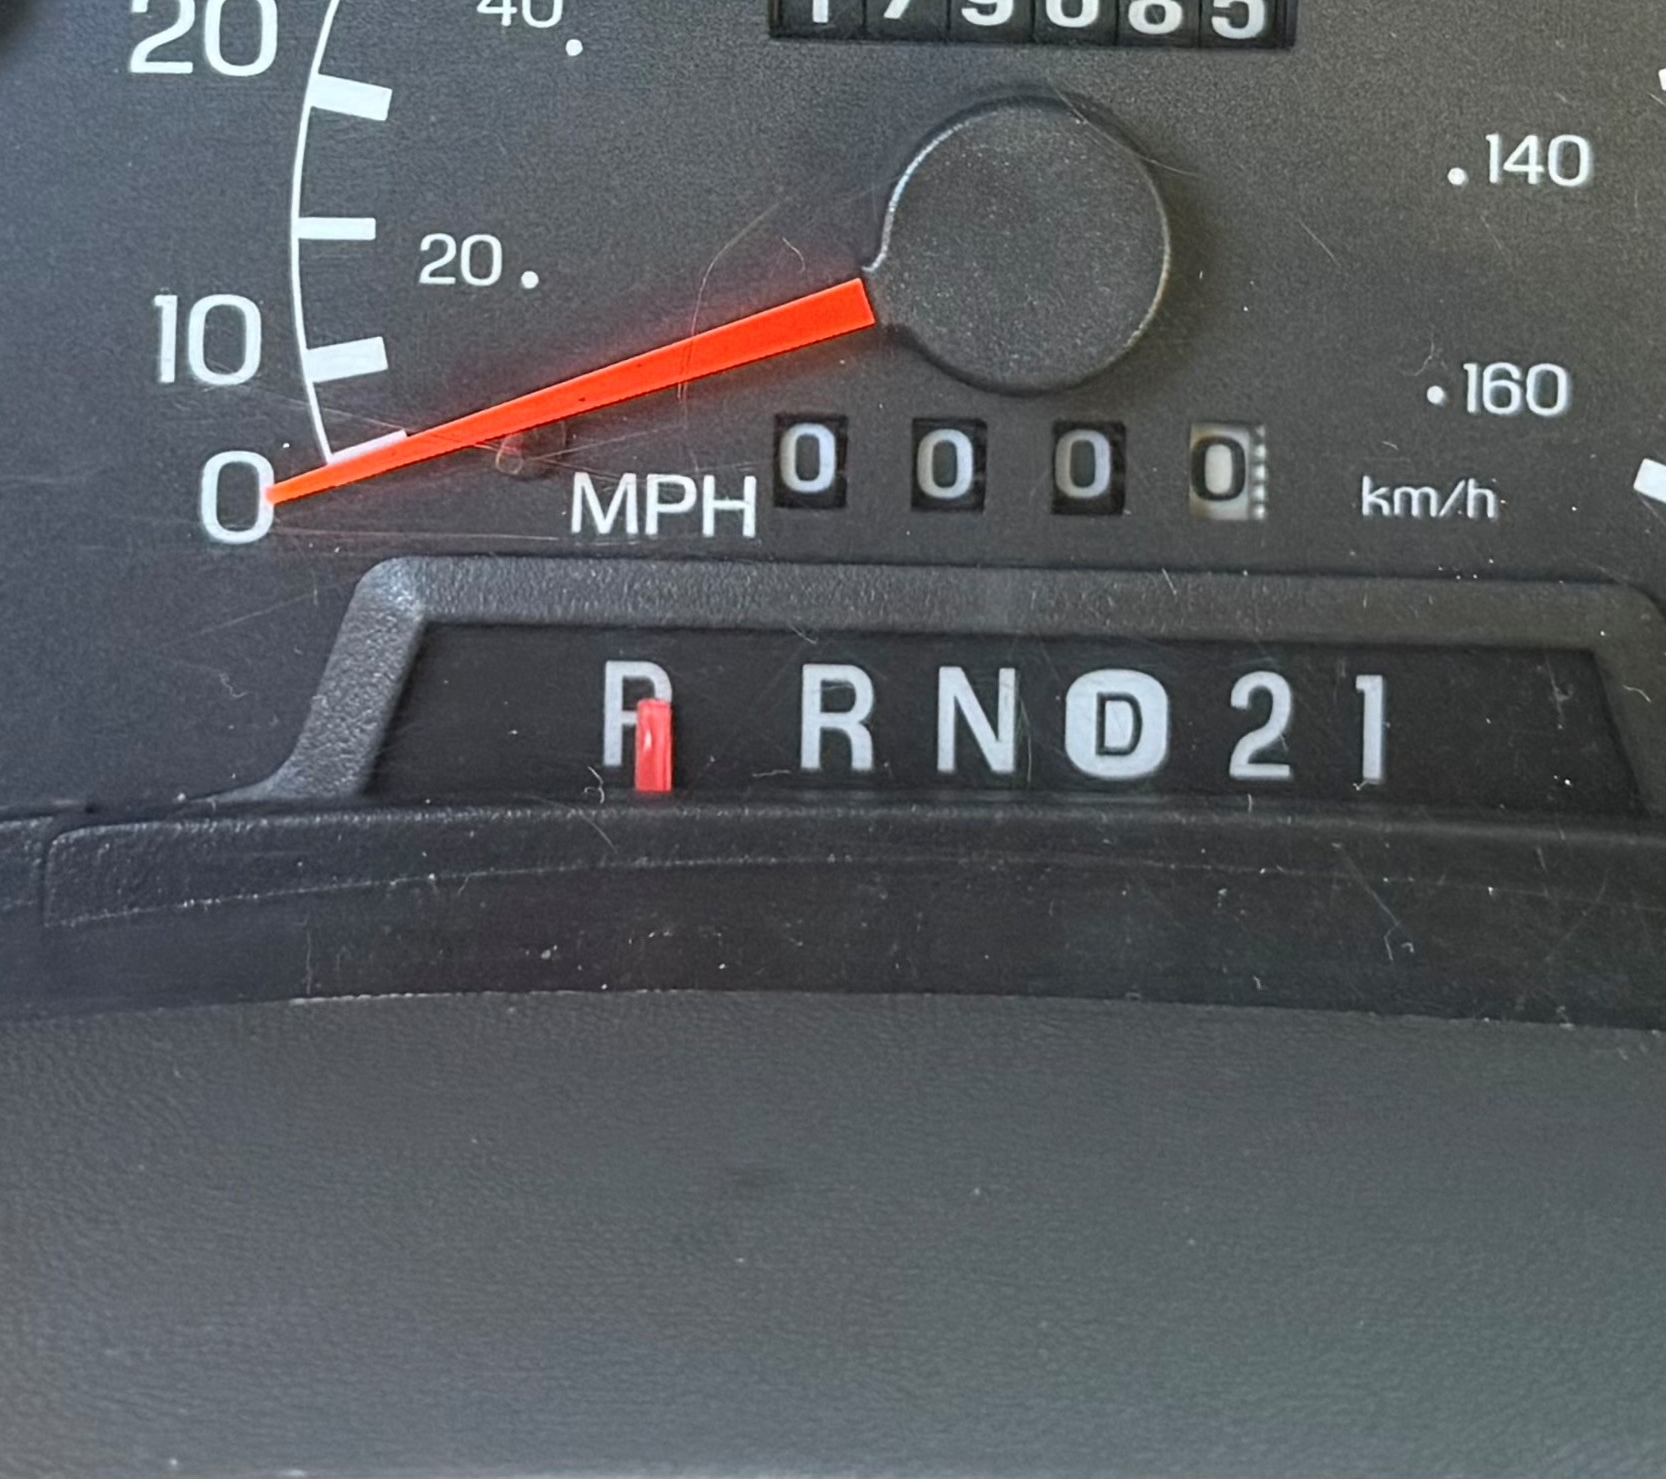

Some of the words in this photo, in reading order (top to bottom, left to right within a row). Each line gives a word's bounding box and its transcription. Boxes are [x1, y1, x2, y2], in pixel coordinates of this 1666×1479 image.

[1485, 132, 1593, 189] 140
[418, 232, 504, 288] 20
[152, 292, 263, 388] 10
[1462, 361, 1570, 418] 160
[199, 449, 276, 545] 0
[570, 471, 758, 539] MPH
[1360, 474, 1498, 520] km/h
[800, 663, 875, 771] R
[937, 666, 1017, 773] N
[1228, 670, 1293, 779] 2
[1355, 674, 1385, 782] 1
